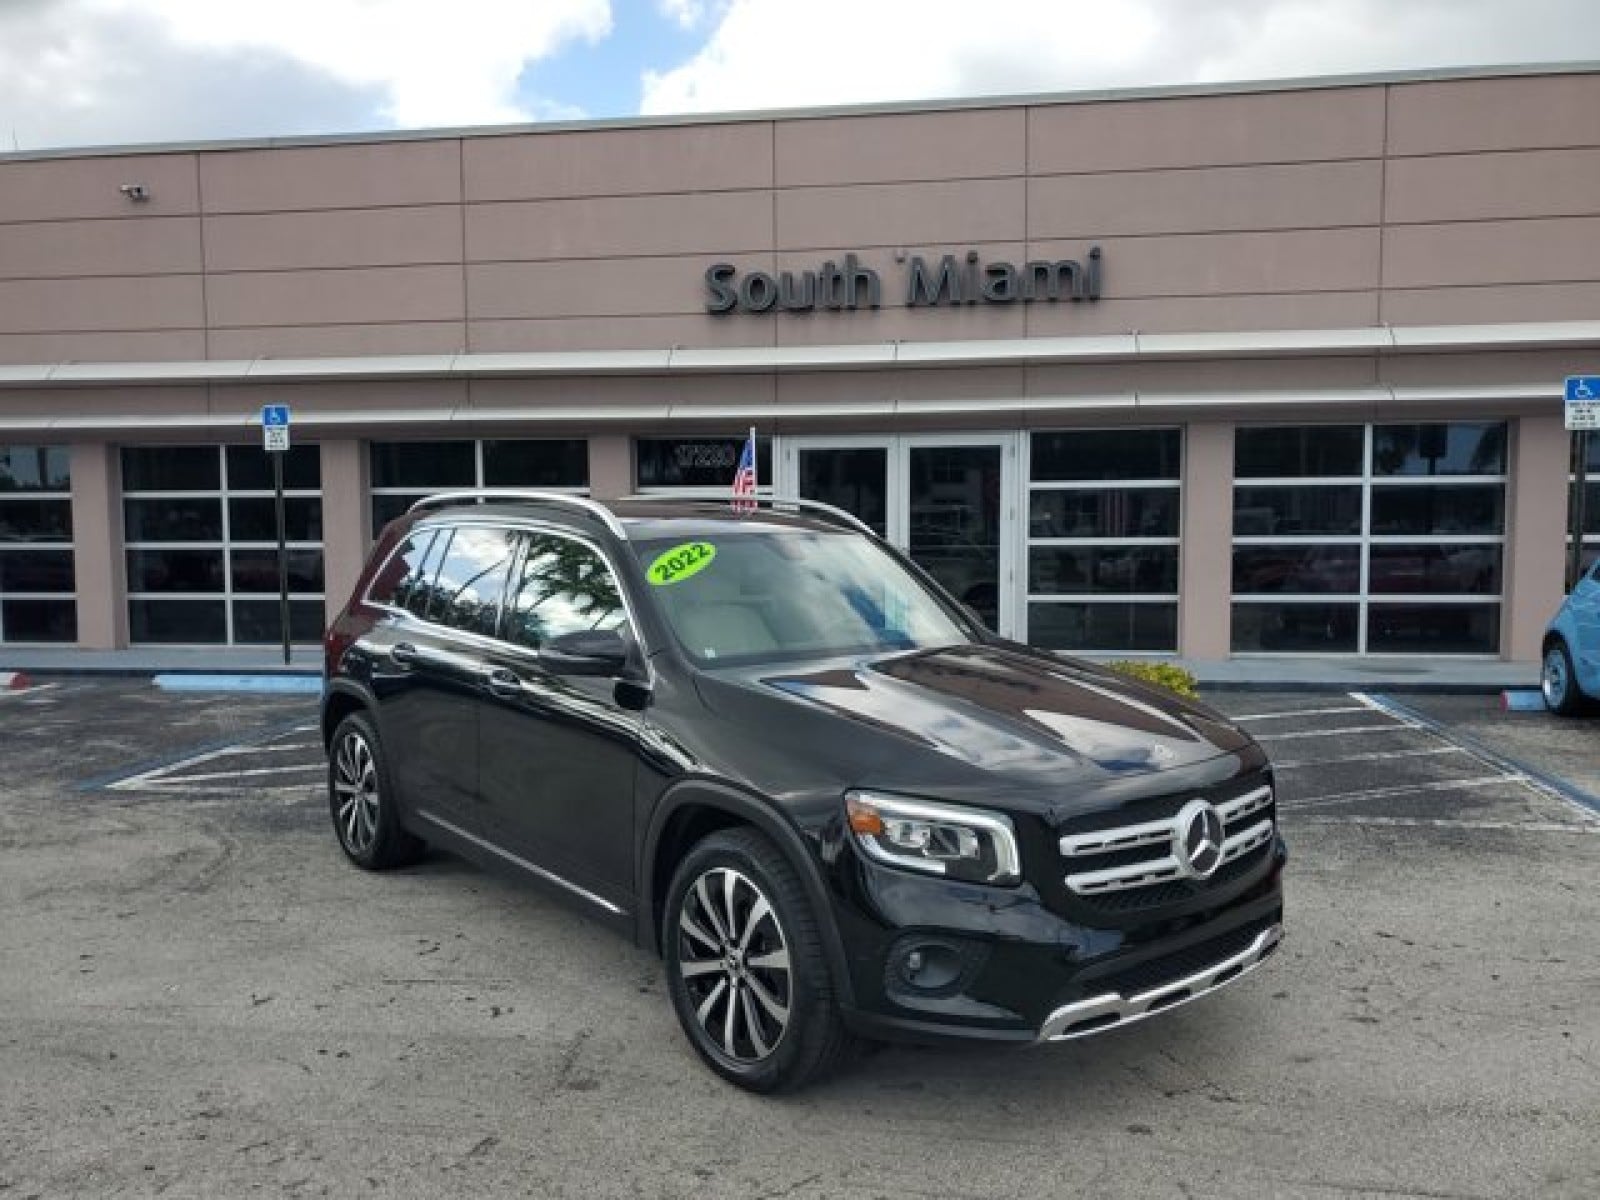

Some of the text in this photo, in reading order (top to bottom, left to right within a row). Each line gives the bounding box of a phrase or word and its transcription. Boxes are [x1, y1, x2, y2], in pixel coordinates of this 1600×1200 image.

[705, 246, 1104, 315] South Miami
[654, 543, 711, 581] 2022
